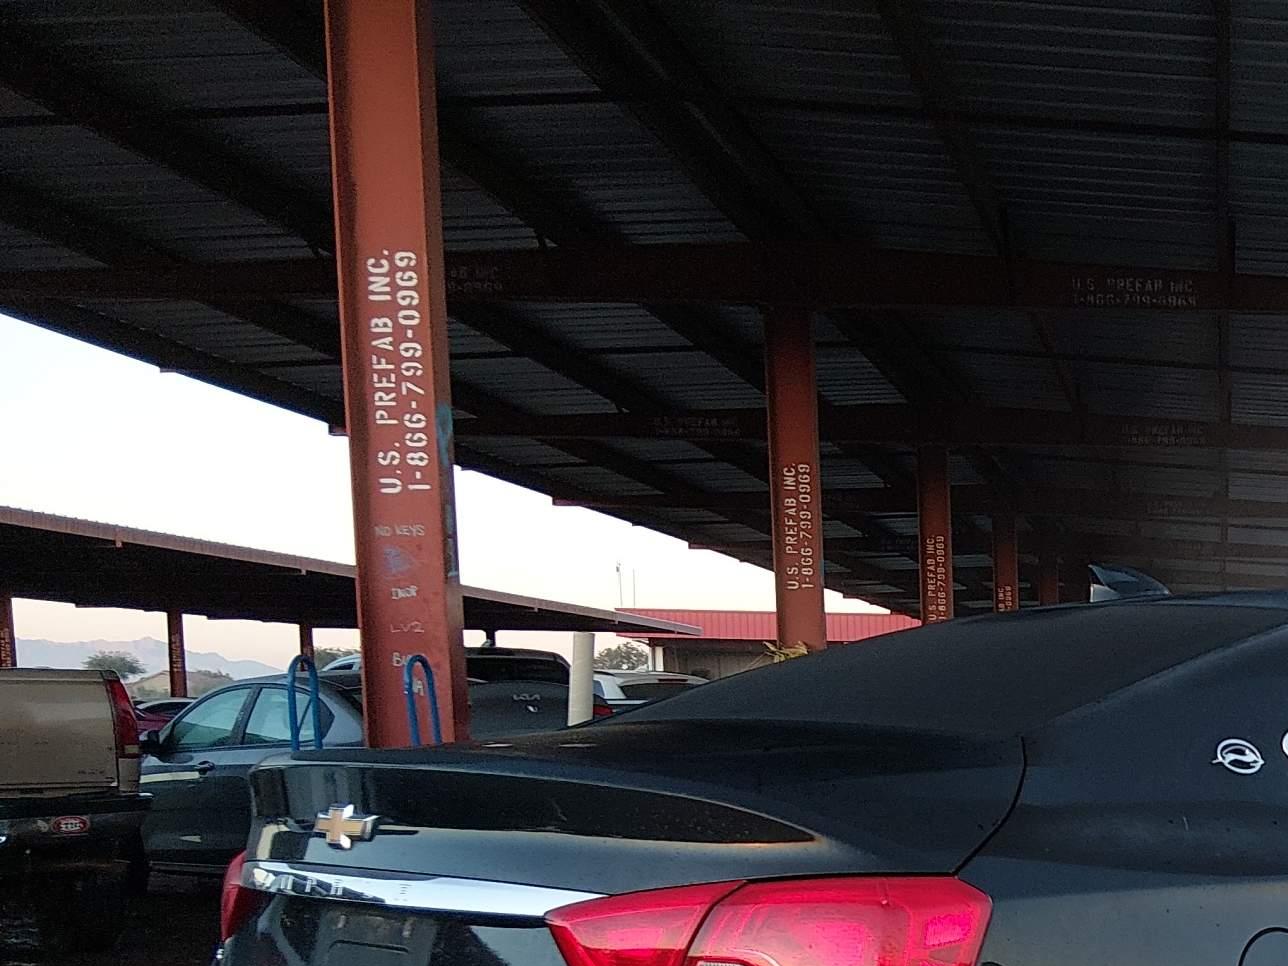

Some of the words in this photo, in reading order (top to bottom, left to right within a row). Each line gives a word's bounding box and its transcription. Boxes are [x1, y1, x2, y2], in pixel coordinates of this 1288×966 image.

[366, 249, 392, 302] INC.
[369, 316, 399, 425] PREFAB
[394, 250, 432, 491] 1-866-799-0969
[377, 443, 402, 494] U.S.
[782, 463, 796, 490] INC.
[374, 525, 390, 537] NO
[395, 524, 425, 537] KEYS
[783, 497, 799, 554] PREFAB
[797, 463, 815, 589] 1-866-799-0969
[786, 561, 800, 590] U.S.
[926, 558, 937, 597] PREFAB
